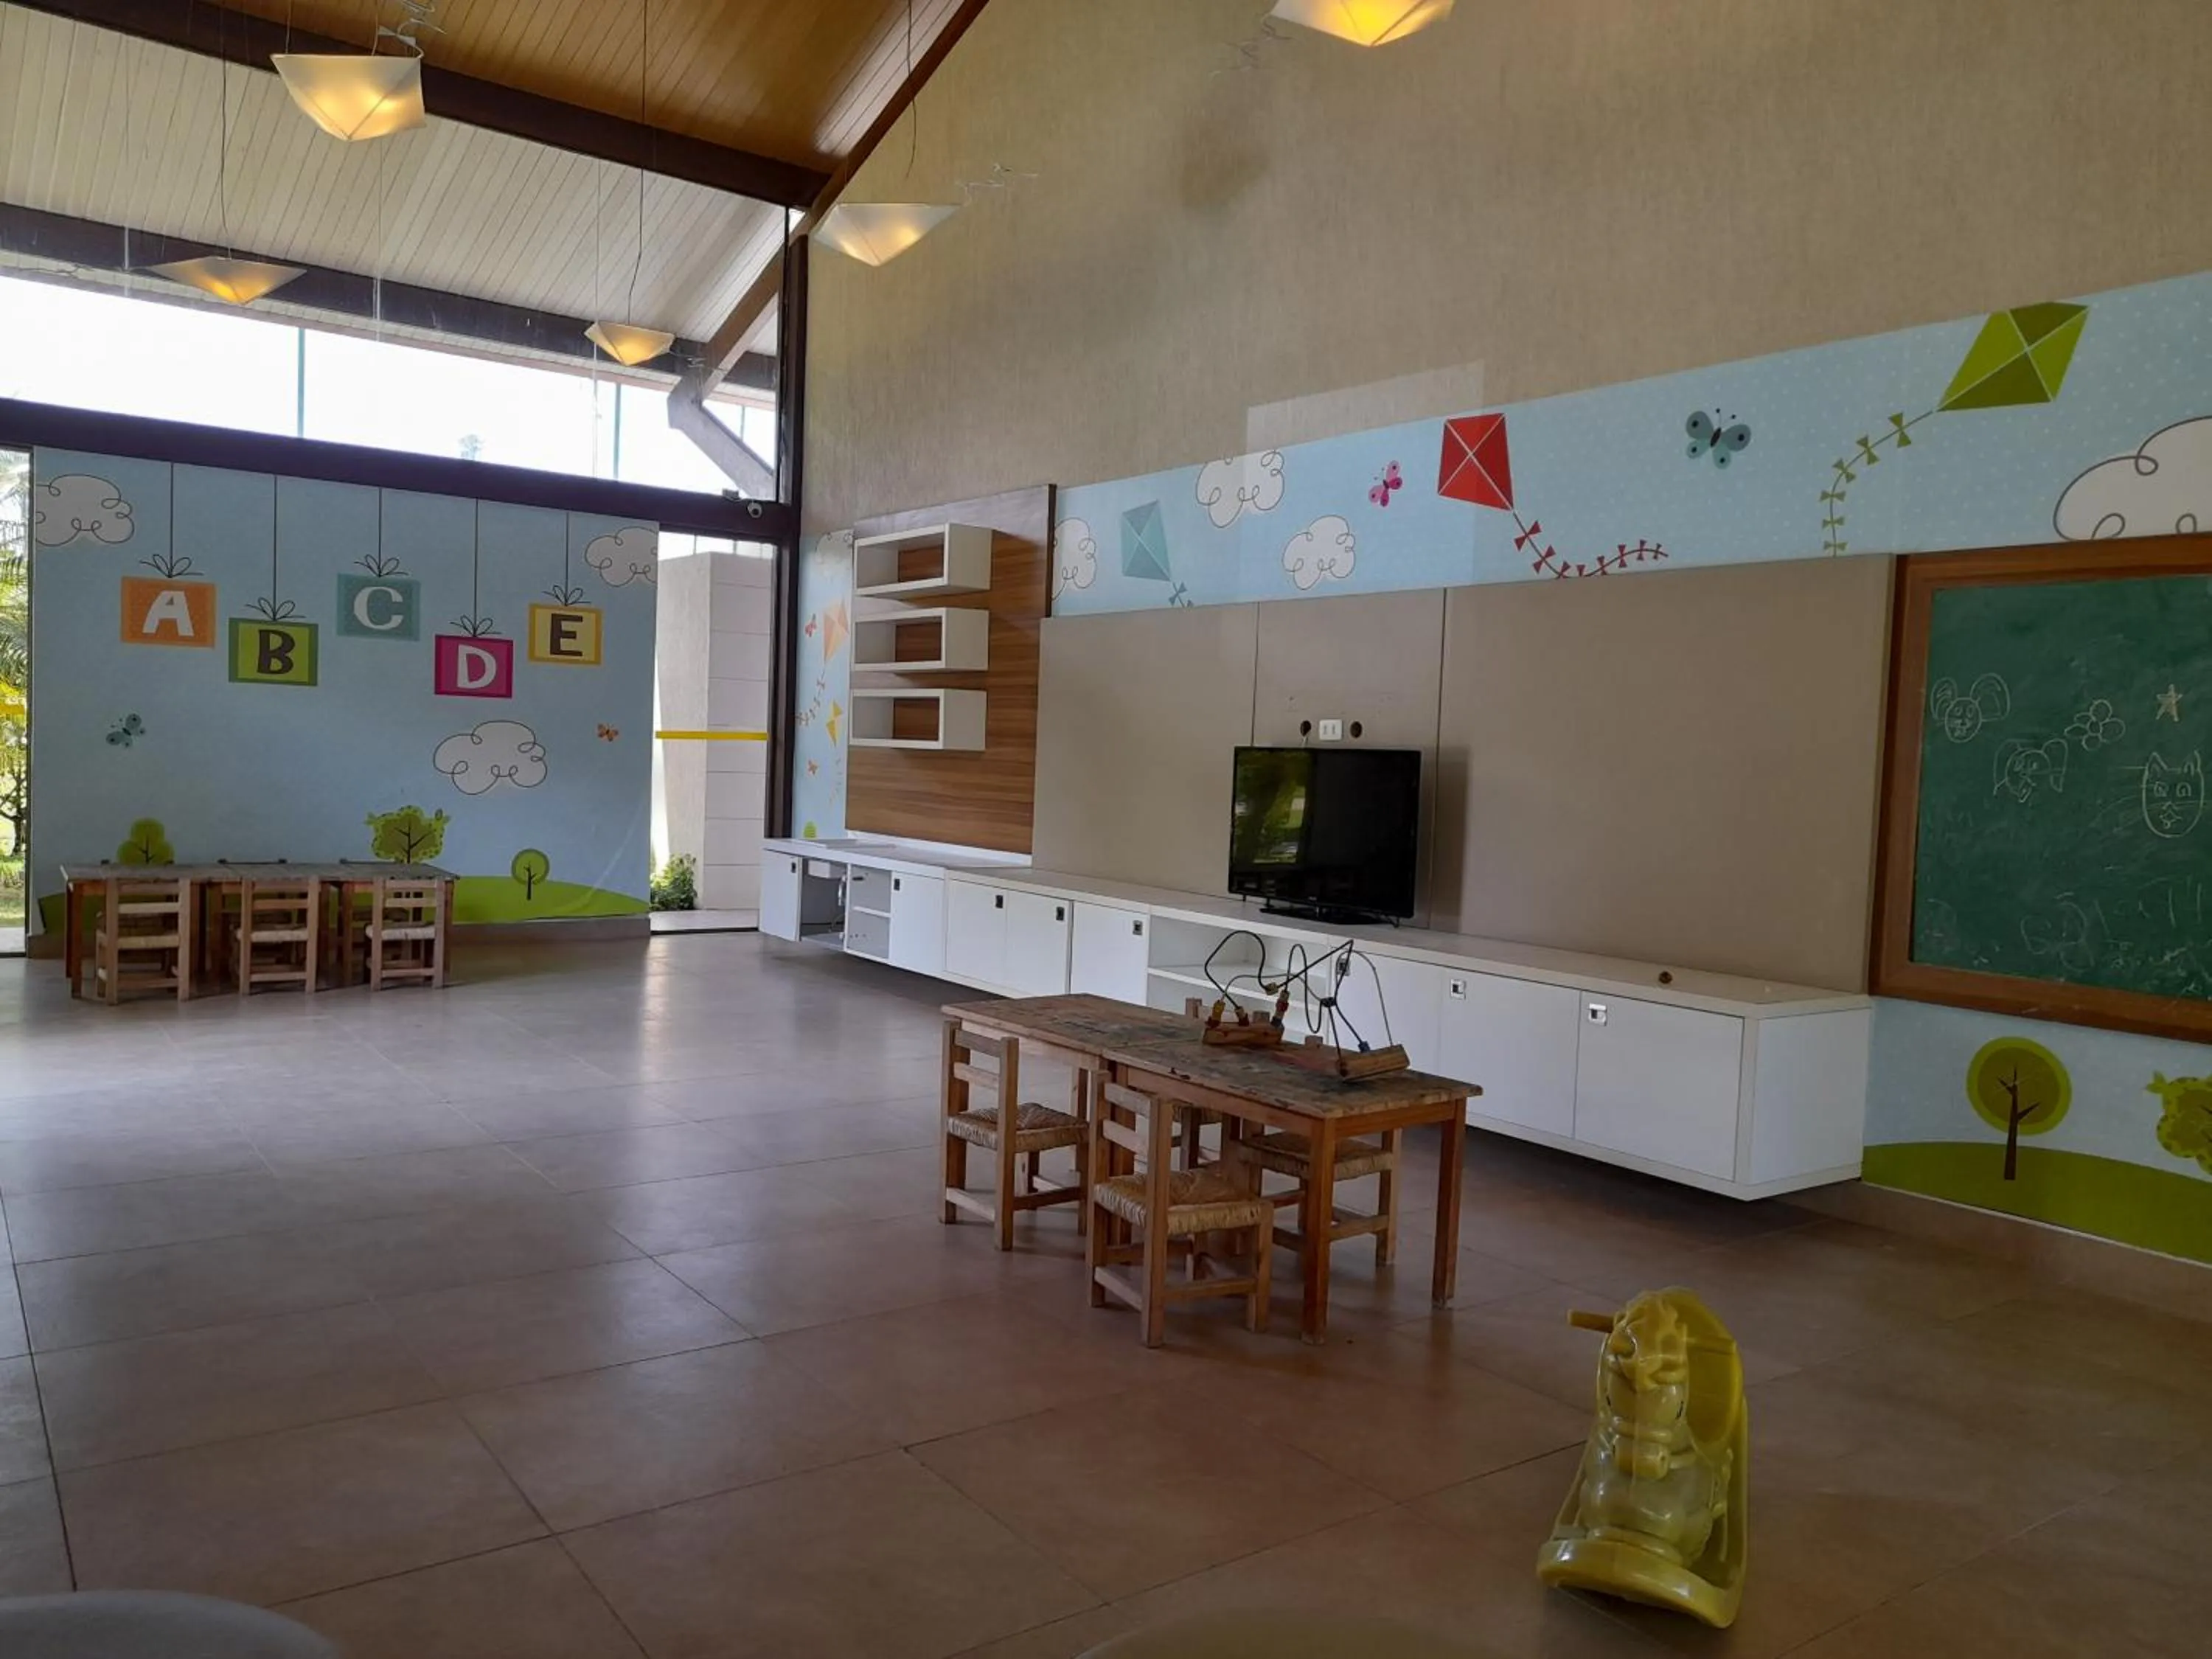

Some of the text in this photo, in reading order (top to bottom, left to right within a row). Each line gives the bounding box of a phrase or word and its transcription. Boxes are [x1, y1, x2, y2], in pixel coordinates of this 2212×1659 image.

[142, 591, 195, 636] A
[353, 586, 403, 630] C
[256, 629, 295, 675] B
[549, 613, 583, 657] E
[456, 644, 498, 689] D
